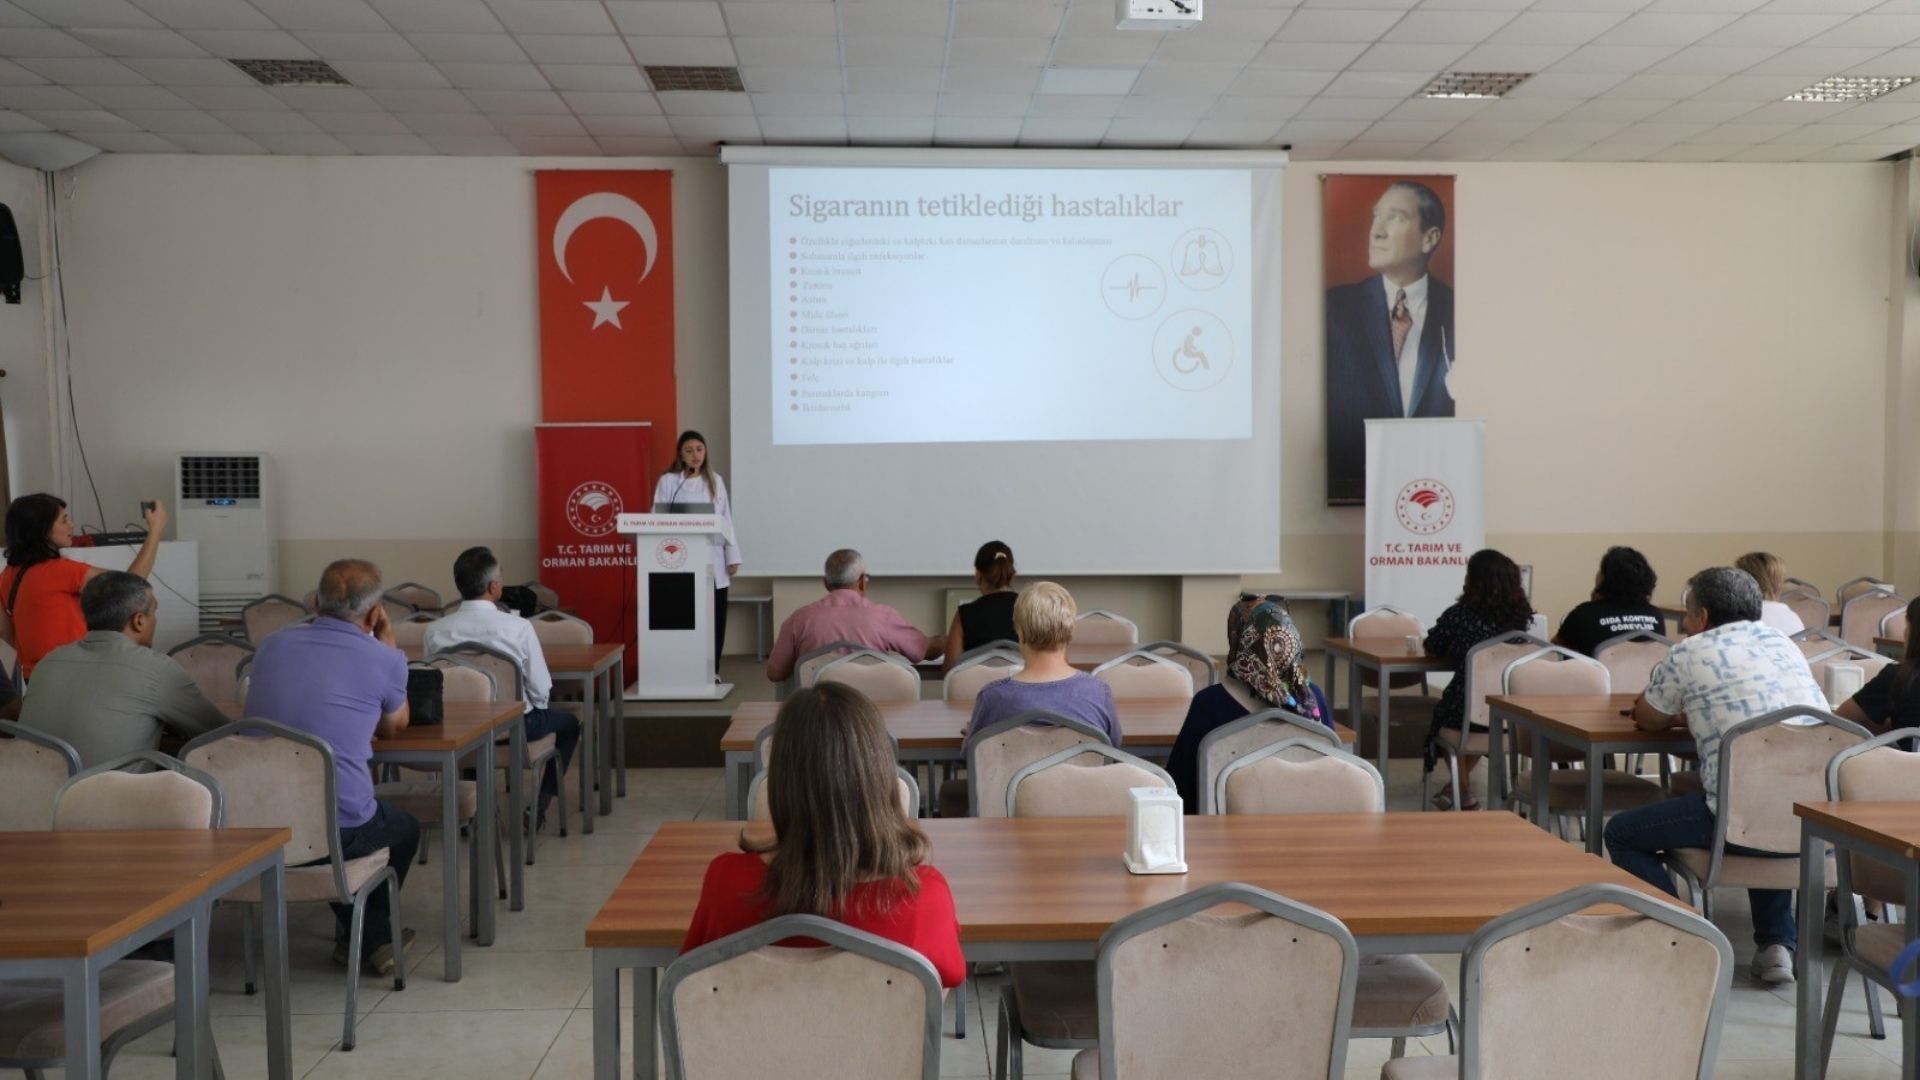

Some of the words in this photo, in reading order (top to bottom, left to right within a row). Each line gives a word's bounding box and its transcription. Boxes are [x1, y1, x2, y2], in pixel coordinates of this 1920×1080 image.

[789, 193, 910, 223] Sigaranın
[918, 193, 1046, 223] tetiklediği
[1051, 193, 1184, 218] hastalıklar
[557, 545, 577, 554] T.C.
[579, 544, 615, 554] TARIM
[616, 544, 631, 554] VE
[1385, 543, 1405, 553] T.C.
[1407, 543, 1444, 553] TARIM
[1447, 543, 1462, 553] VE
[542, 557, 586, 567] ORMAN
[588, 556, 638, 567] BAKANLI
[1369, 556, 1414, 566] ORMAN
[1600, 616, 1621, 626] GIDA
[1622, 615, 1658, 624] KONTROL
